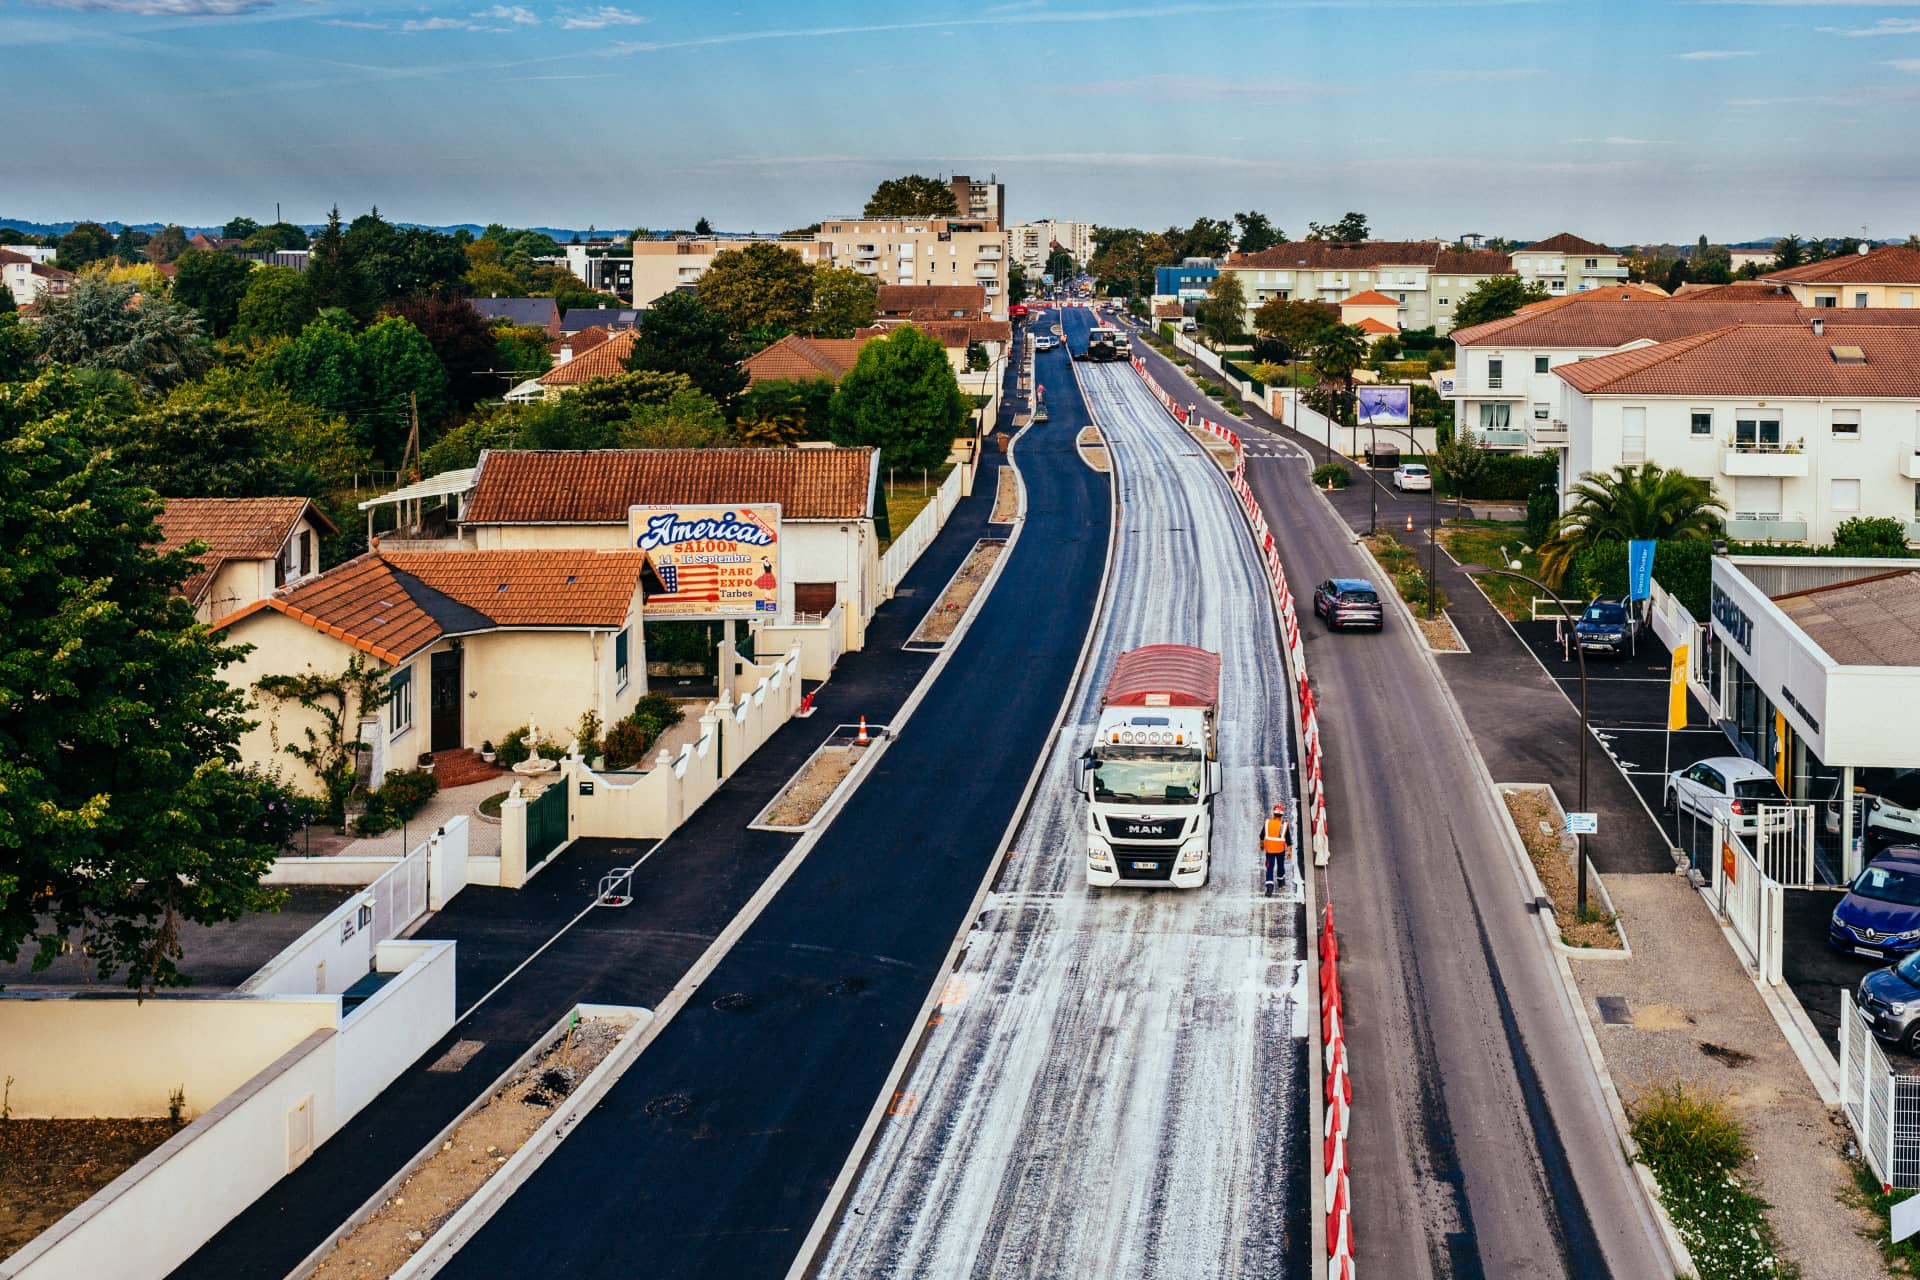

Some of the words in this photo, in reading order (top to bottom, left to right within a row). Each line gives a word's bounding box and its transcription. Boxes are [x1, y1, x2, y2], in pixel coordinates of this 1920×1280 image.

[638, 512, 772, 550] American
[674, 540, 738, 553] SALOON
[660, 554, 672, 564] 14
[681, 554, 693, 564] 16
[695, 553, 752, 564] Septembre
[720, 567, 753, 576] PARC
[720, 579, 753, 588] EXPO
[720, 589, 753, 598] Tarbes
[1129, 825, 1163, 834] MAN
